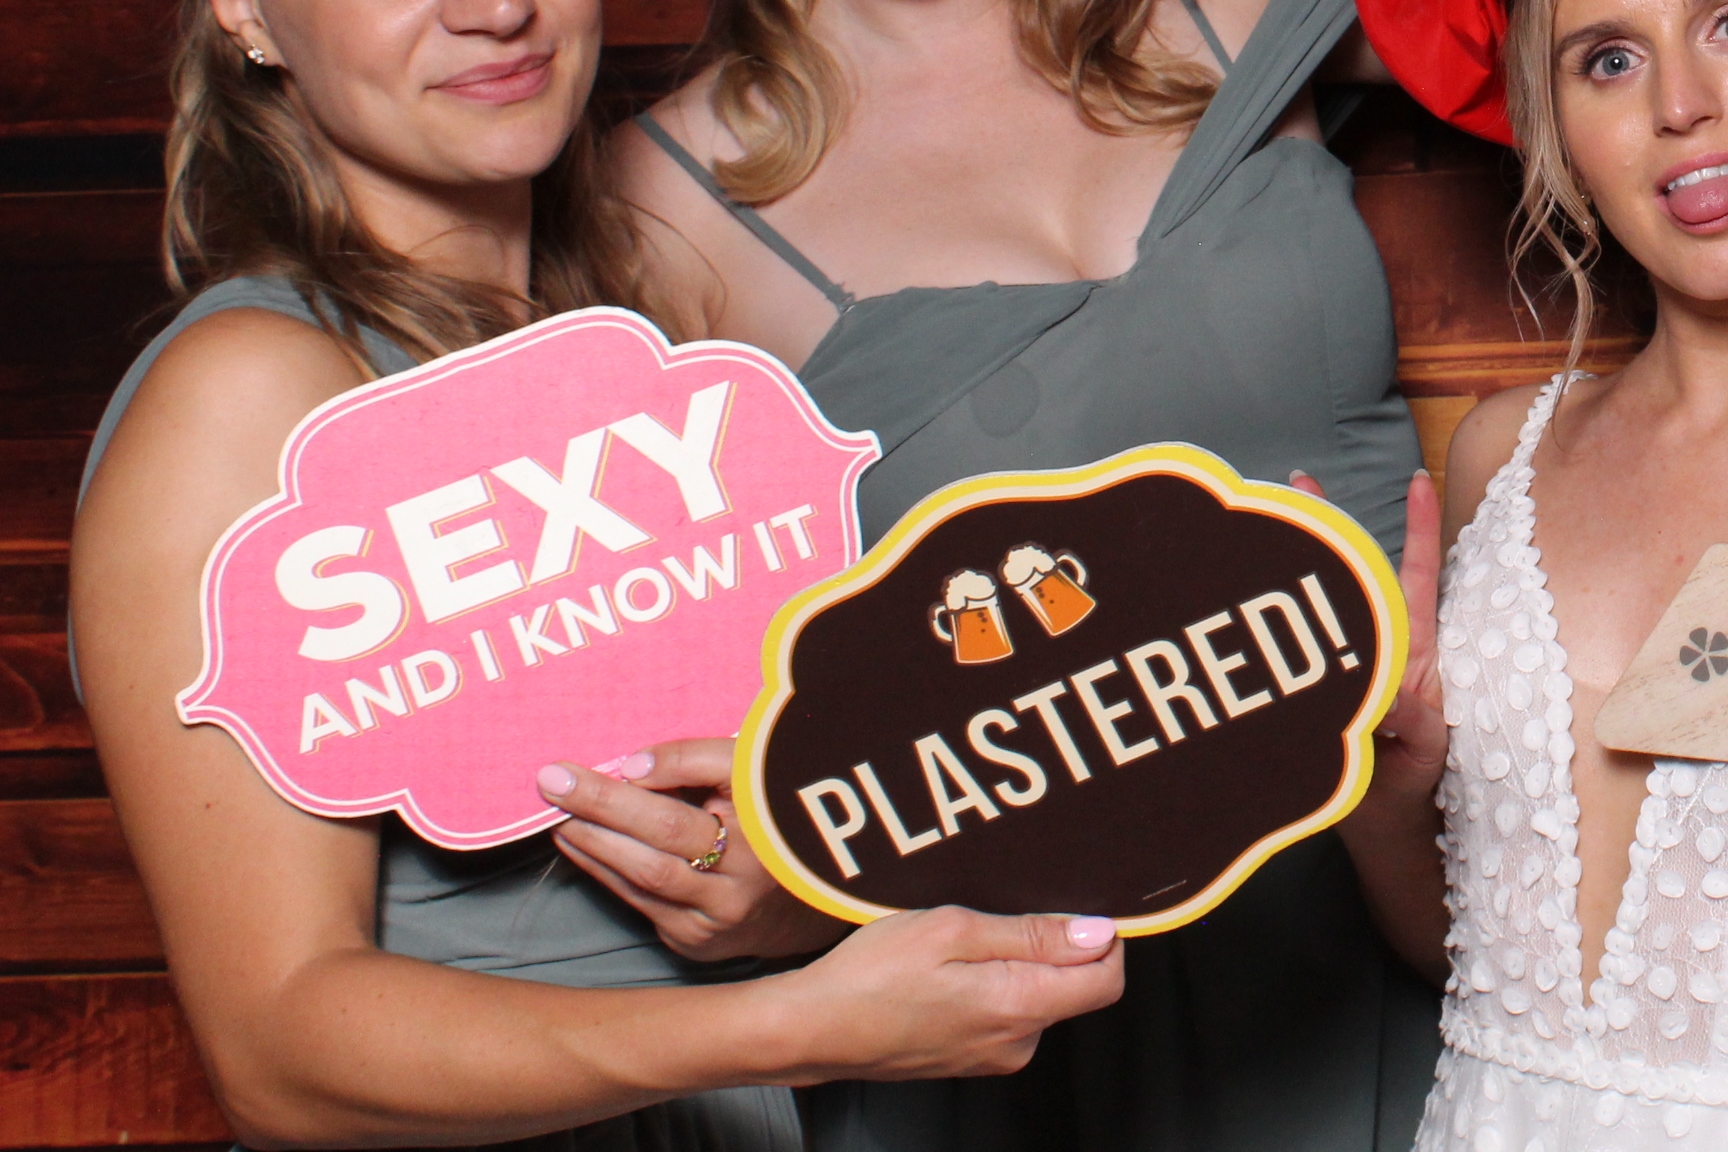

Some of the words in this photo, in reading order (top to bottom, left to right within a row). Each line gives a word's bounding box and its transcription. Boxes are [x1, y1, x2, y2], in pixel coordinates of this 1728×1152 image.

[275, 380, 736, 662] SEXY
[299, 649, 462, 755] AND
[470, 629, 504, 683] I
[509, 533, 741, 668] KNOW
[753, 503, 819, 573] IT
[797, 573, 1361, 881] PLASTERED!
